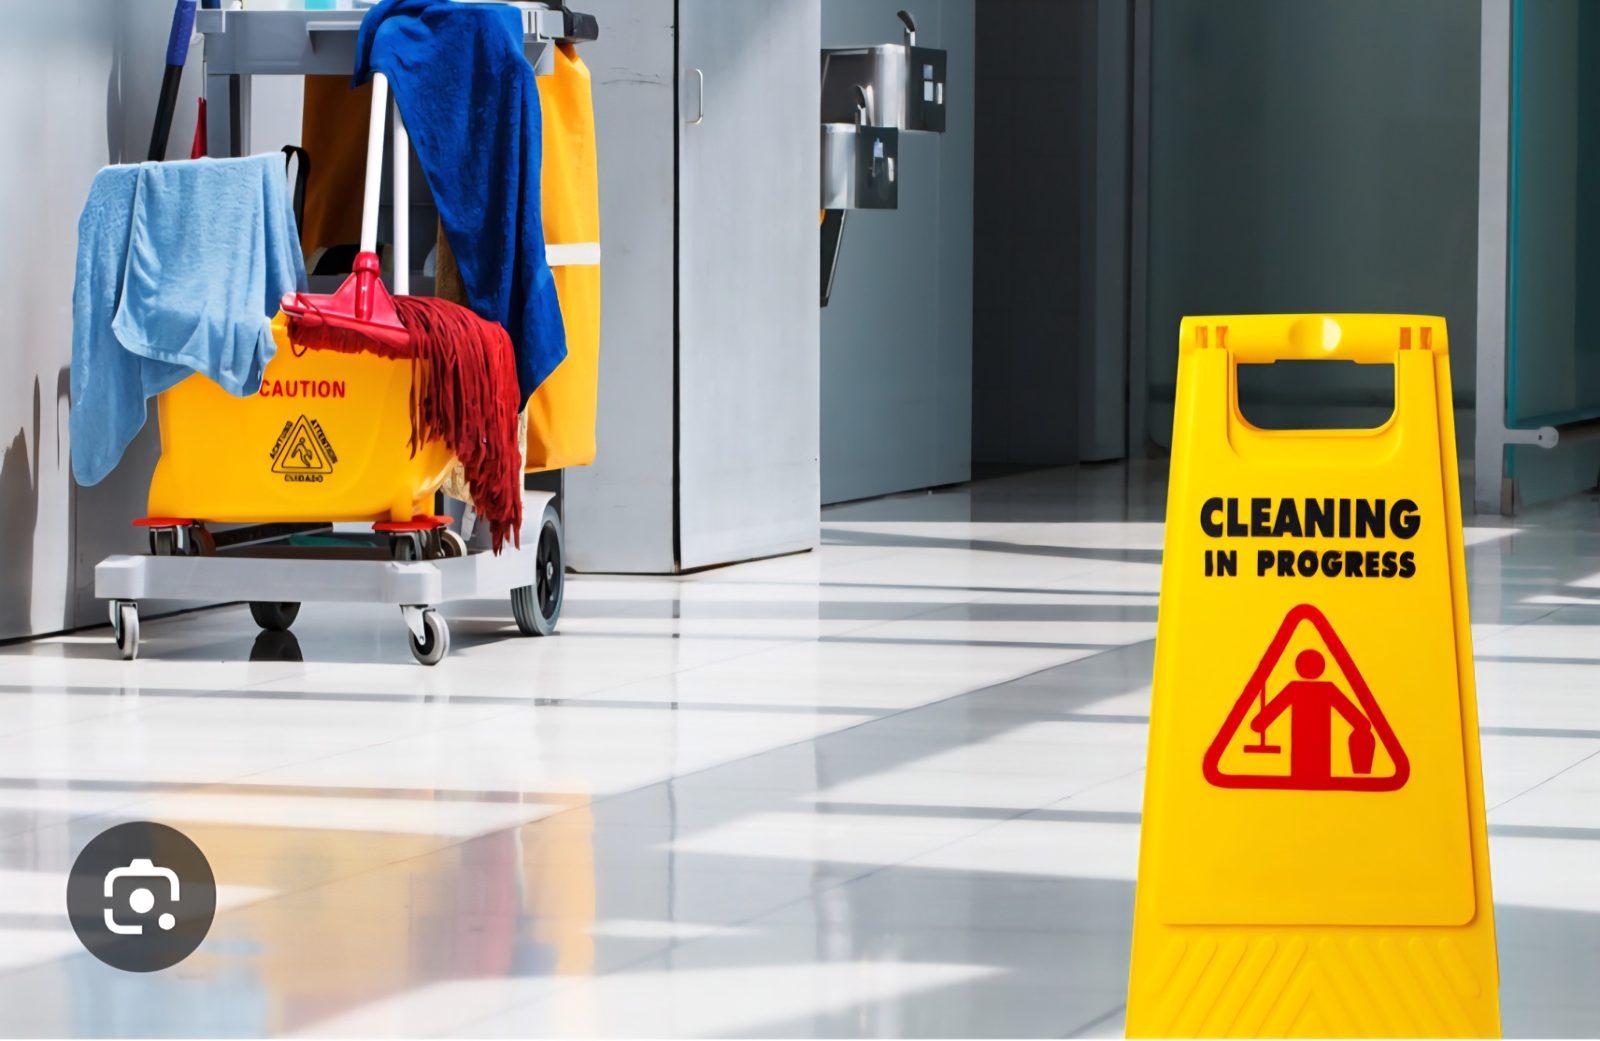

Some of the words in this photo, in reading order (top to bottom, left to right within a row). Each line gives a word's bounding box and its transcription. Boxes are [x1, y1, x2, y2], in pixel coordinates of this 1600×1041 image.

[260, 379, 345, 398] CAUTION
[1200, 497, 1421, 539] CLEANING
[1204, 550, 1237, 577] IN
[1257, 550, 1416, 579] PROGRESS
